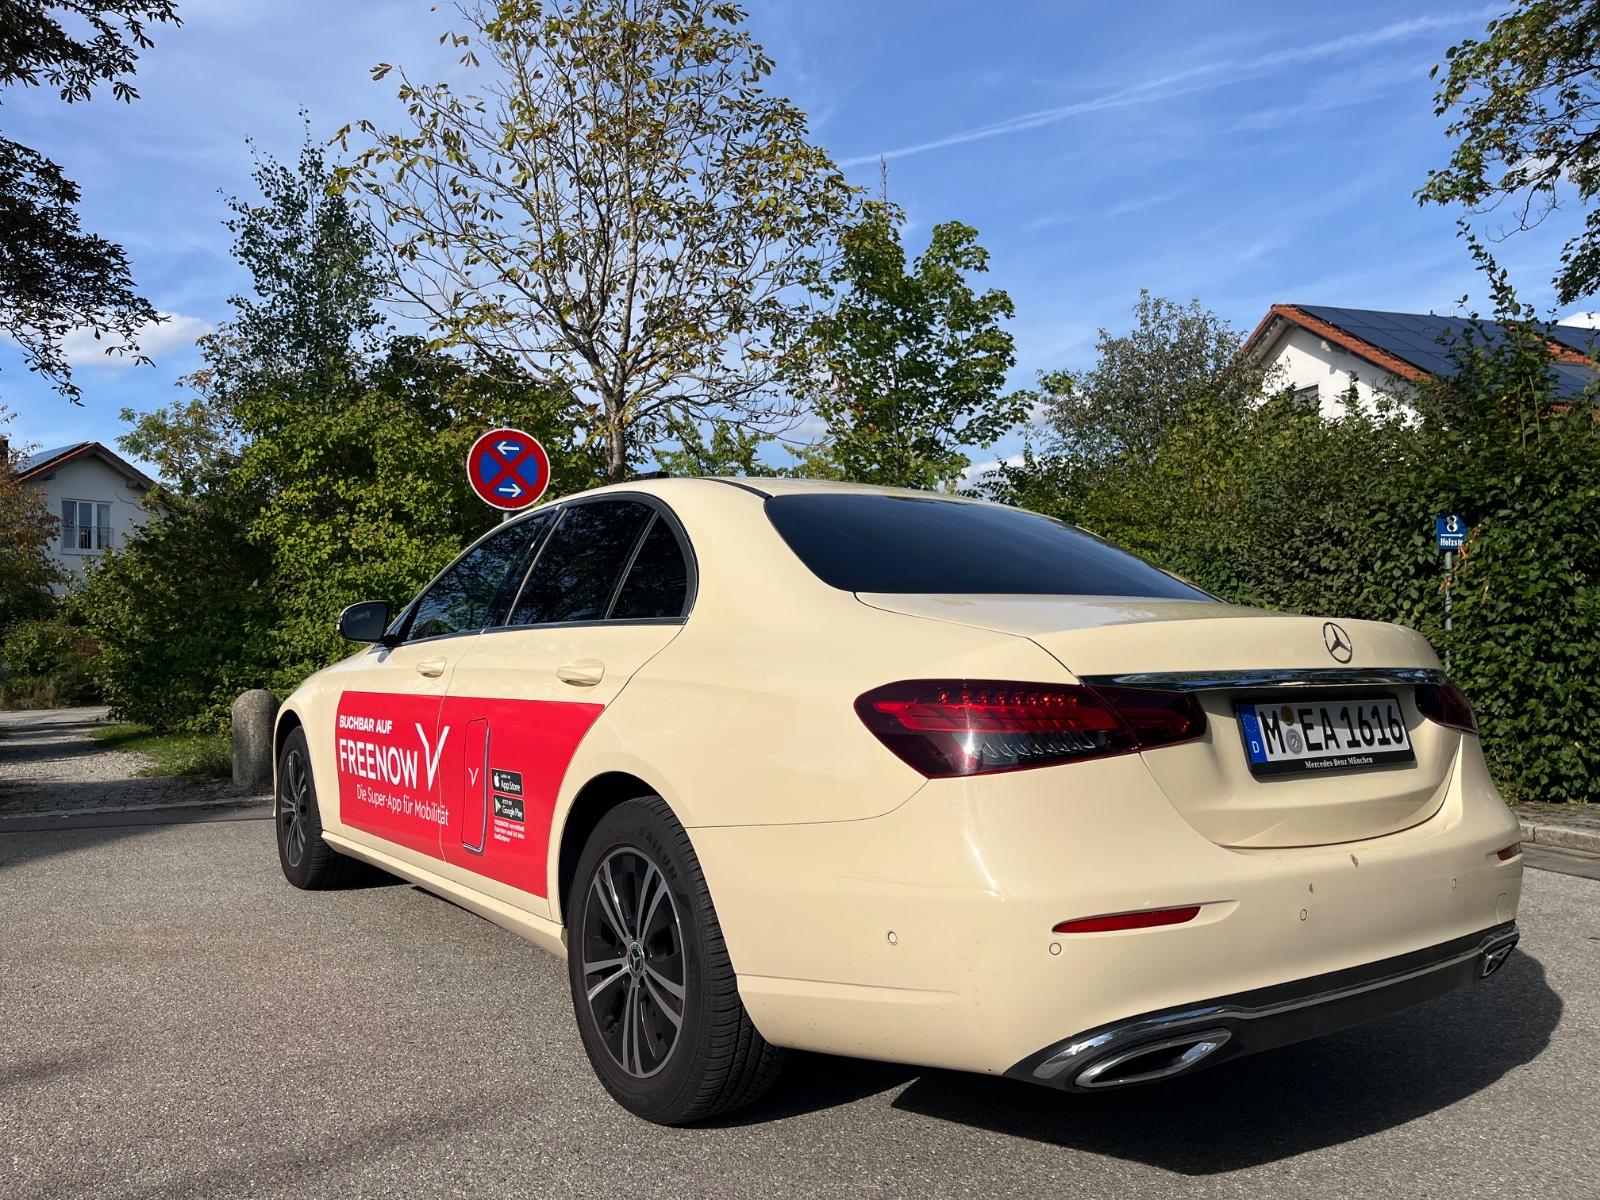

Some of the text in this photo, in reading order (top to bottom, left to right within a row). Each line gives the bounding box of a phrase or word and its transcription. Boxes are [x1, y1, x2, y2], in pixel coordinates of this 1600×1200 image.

[1446, 514, 1458, 533] 8
[339, 715, 393, 735] BUCHBAR AUF
[1259, 704, 1404, 755] M EA 1616
[1251, 740, 1260, 754] D
[339, 738, 418, 790] FREENOW
[1347, 756, 1373, 765] München
[356, 784, 450, 827] Die Super-App für Mobilität
